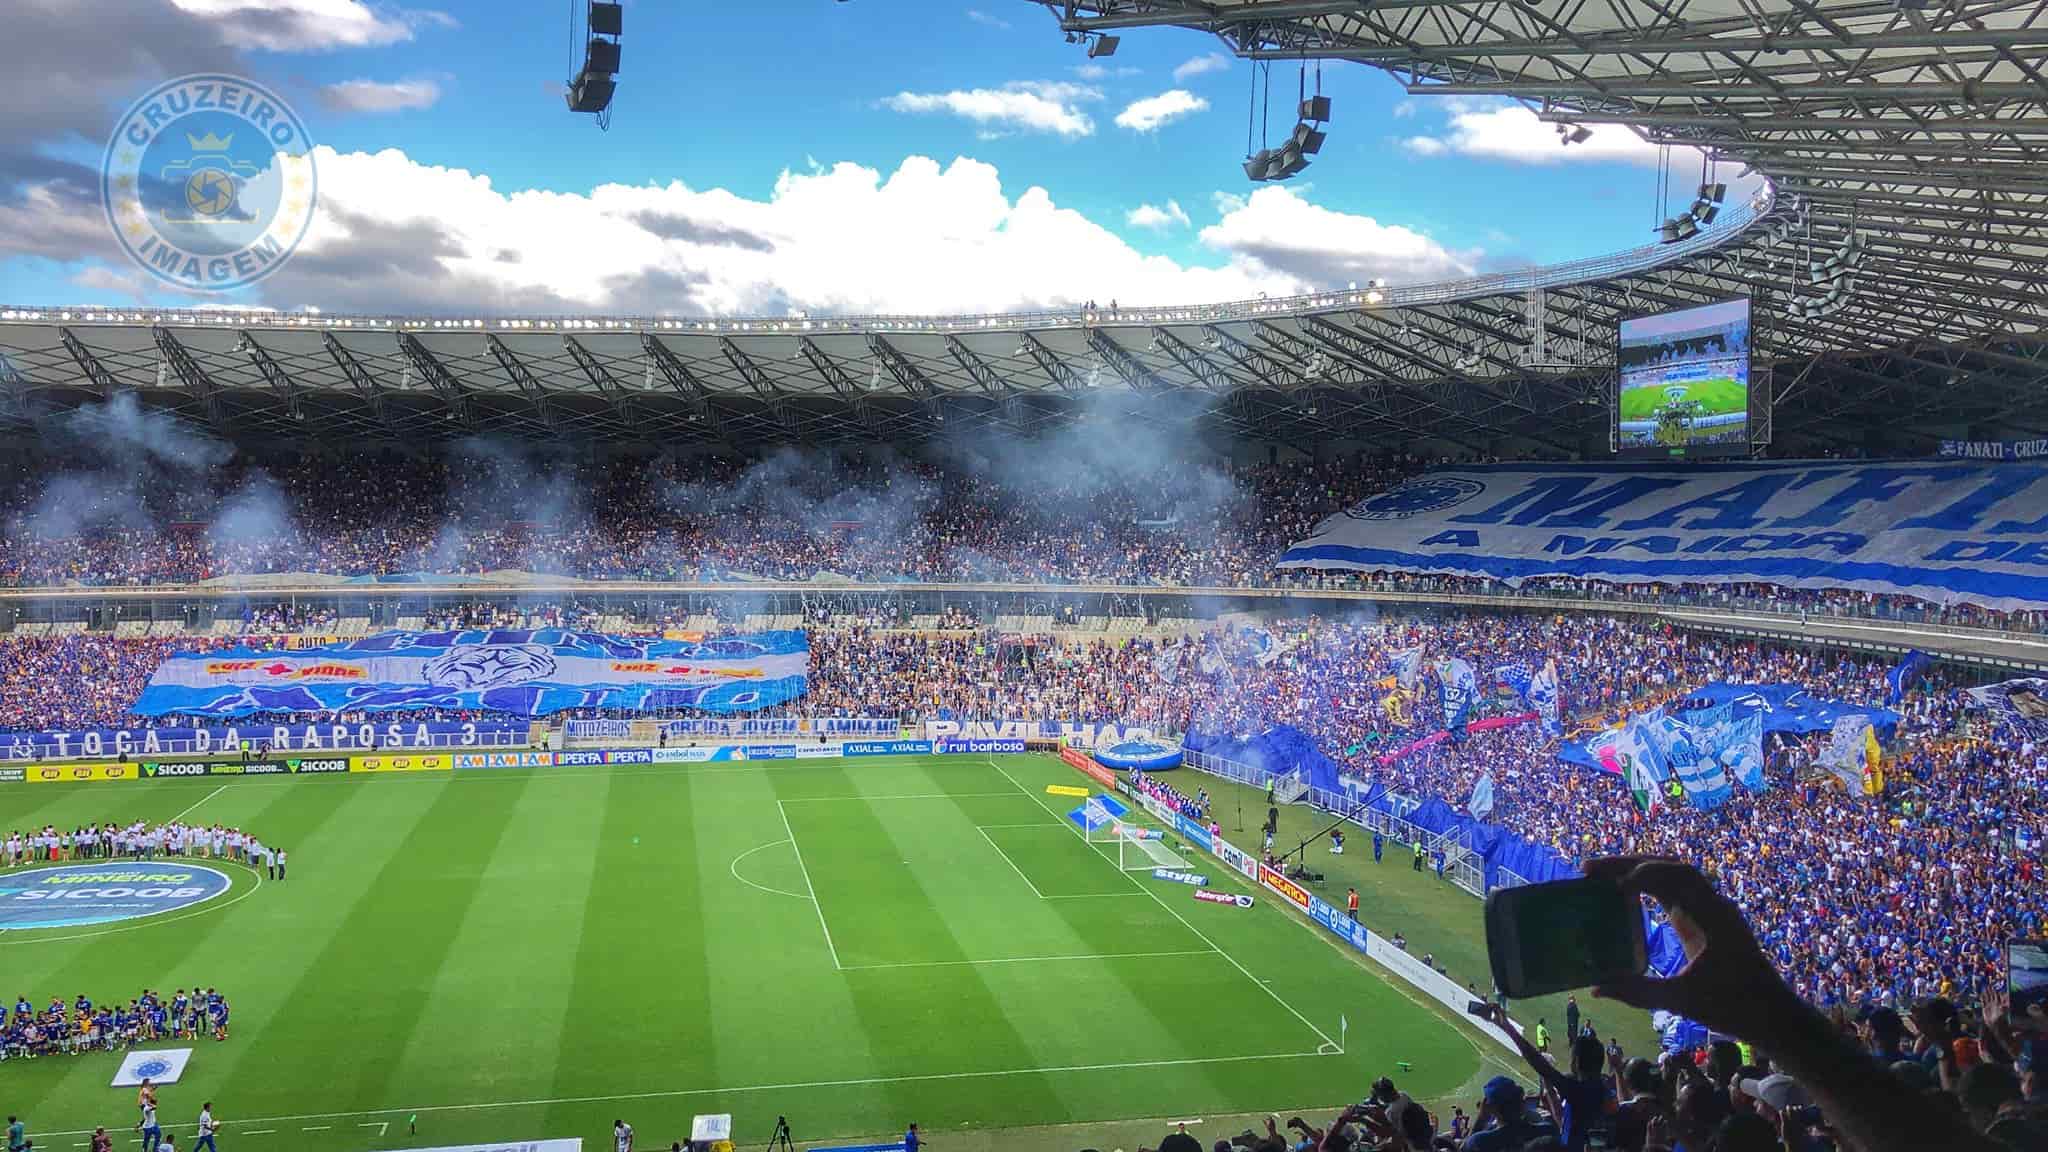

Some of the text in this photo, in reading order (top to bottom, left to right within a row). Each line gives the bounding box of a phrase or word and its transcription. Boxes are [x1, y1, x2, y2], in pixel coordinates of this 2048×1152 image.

[1418, 530, 1480, 546] A
[1542, 531, 1869, 556] MAIOR
[298, 637, 327, 649] AUTO
[567, 720, 631, 736] MOTOZEIROS
[53, 723, 476, 757] TOCA DA RAPOSA 3
[949, 740, 1024, 752] rui barbosa
[848, 744, 873, 753] AXIAL
[891, 743, 915, 752] AXIAL
[158, 764, 204, 775] SICOOB
[301, 760, 345, 772] SICOOB
[43, 874, 193, 884] MINEIRO
[15, 887, 205, 900] SICOOB
[1268, 873, 1307, 906] MEGATRON
